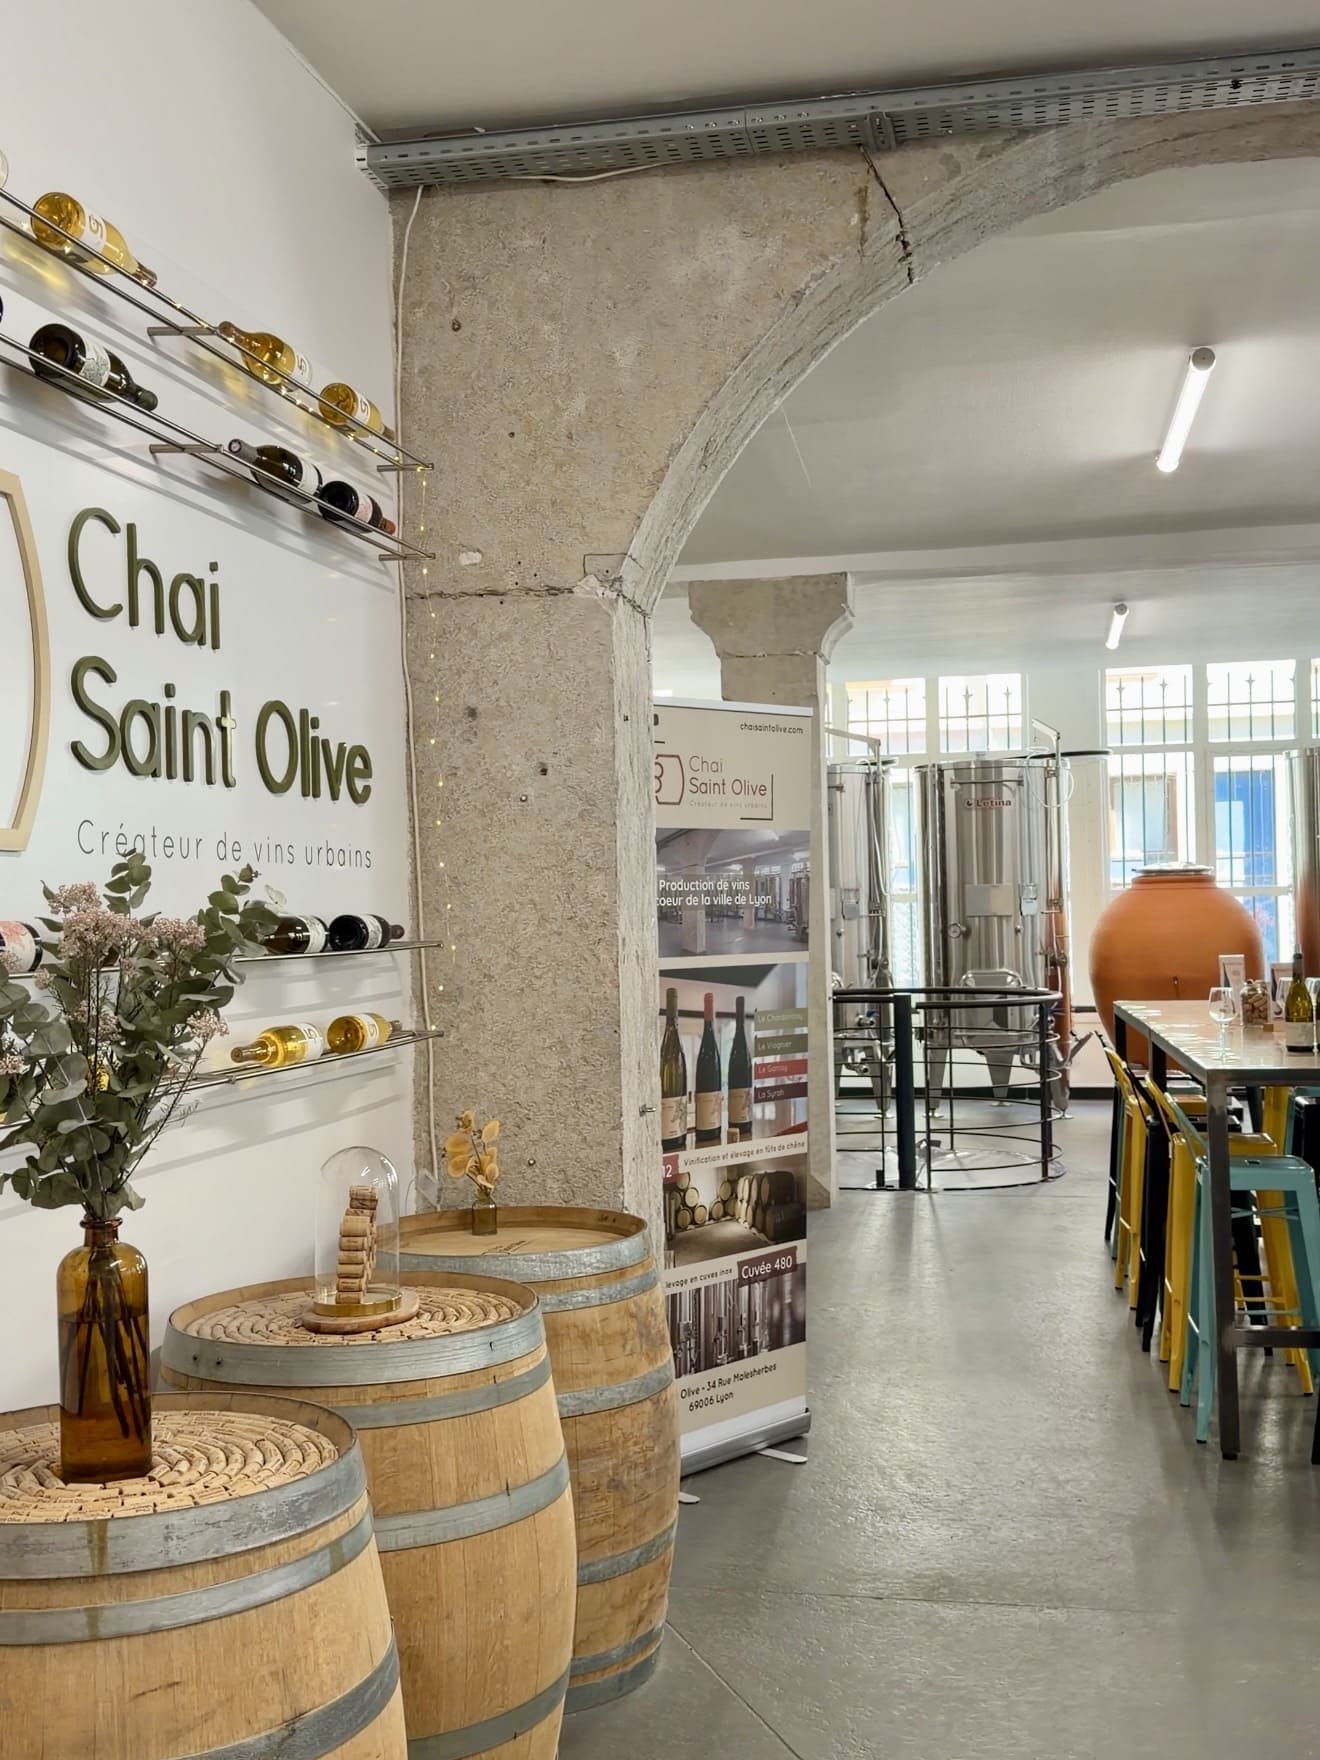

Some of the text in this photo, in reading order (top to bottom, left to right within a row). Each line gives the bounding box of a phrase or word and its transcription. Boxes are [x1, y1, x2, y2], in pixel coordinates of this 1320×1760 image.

[67, 507, 220, 650] Chai
[70, 655, 373, 804] Saint Olive
[740, 722, 803, 734] chaisaintolive.com
[689, 756, 723, 773] Chai
[689, 777, 767, 796] Saint Olive
[77, 819, 373, 869] Créateur de vins urbains
[659, 880, 750, 891] Production de vins
[686, 894, 699, 906] de
[702, 894, 711, 905] la
[713, 894, 732, 904] ville
[735, 894, 747, 904] de
[749, 893, 772, 907] Lyon
[684, 1155, 721, 1166] Vinification
[777, 1143, 786, 1152] de
[787, 1140, 805, 1150] chêne
[700, 1271, 718, 1281] cuves
[741, 1255, 793, 1279] Cuvée 480
[680, 1386, 700, 1399] Olive
[707, 1381, 717, 1391] 34
[718, 1378, 732, 1387] Rue
[733, 1363, 777, 1382] Malesherbes
[688, 1391, 734, 1412] 69006 Lyon
